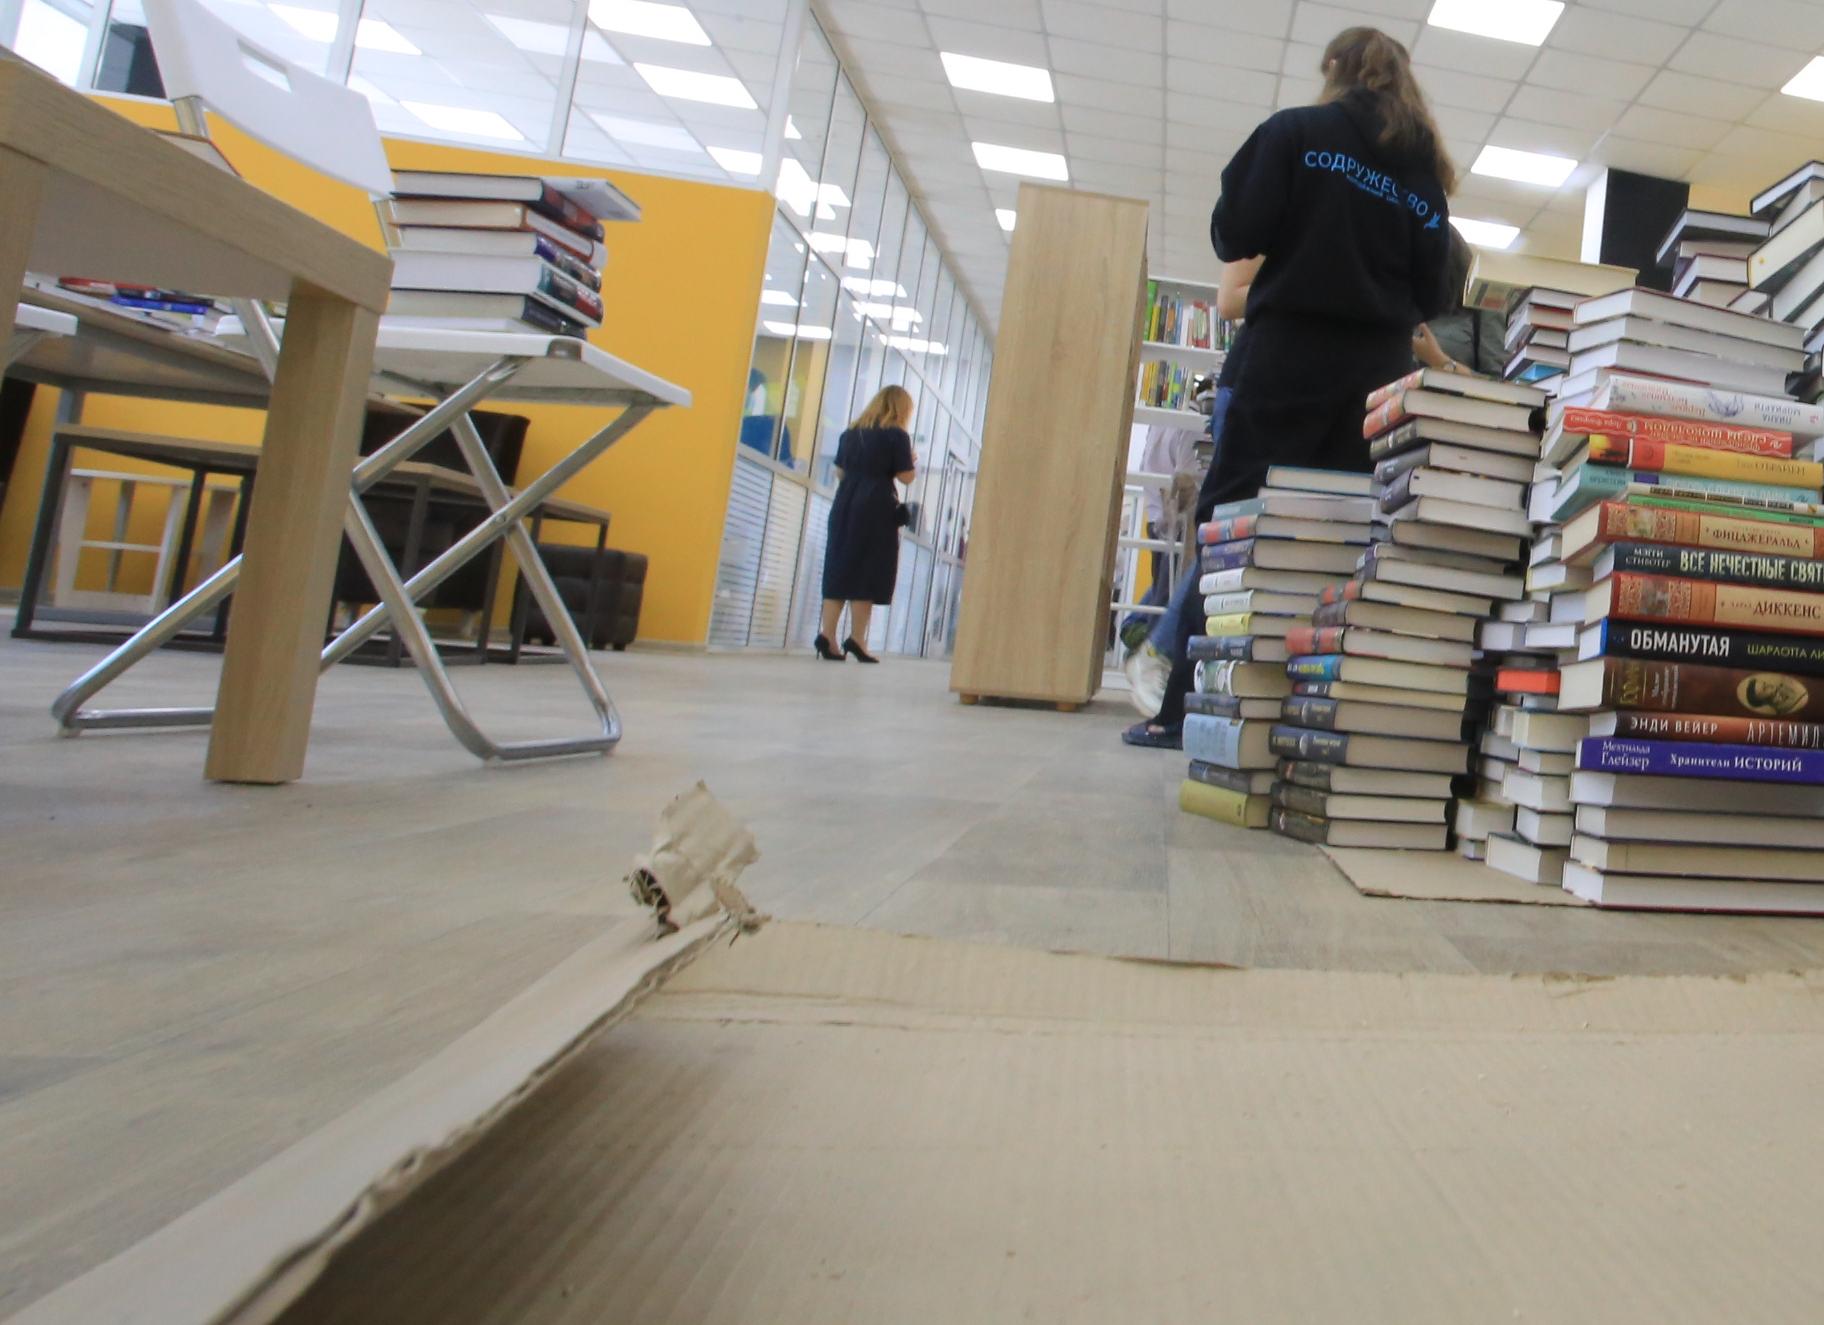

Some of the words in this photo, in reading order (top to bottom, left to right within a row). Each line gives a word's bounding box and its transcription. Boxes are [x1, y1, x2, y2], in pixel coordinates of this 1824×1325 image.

[1304, 150, 1428, 217] СОДРУЖЕСВО
[1679, 550, 1705, 574] ВСЕ
[1708, 553, 1786, 581] НЕЧЕСТНЫЕ
[1752, 599, 1822, 620] ДИККЕНС
[1630, 628, 1730, 658] ОБМАНУТАЯ
[1746, 643, 1808, 661] ШАРЛОТТА
[1629, 716, 1669, 733] ЭНДИ
[1674, 718, 1719, 736] ВЕЙЕР
[1600, 752, 1650, 770] Глейзер
[1669, 753, 1731, 770] Хранители
[1734, 755, 1802, 773] ИСТОРИЙ
